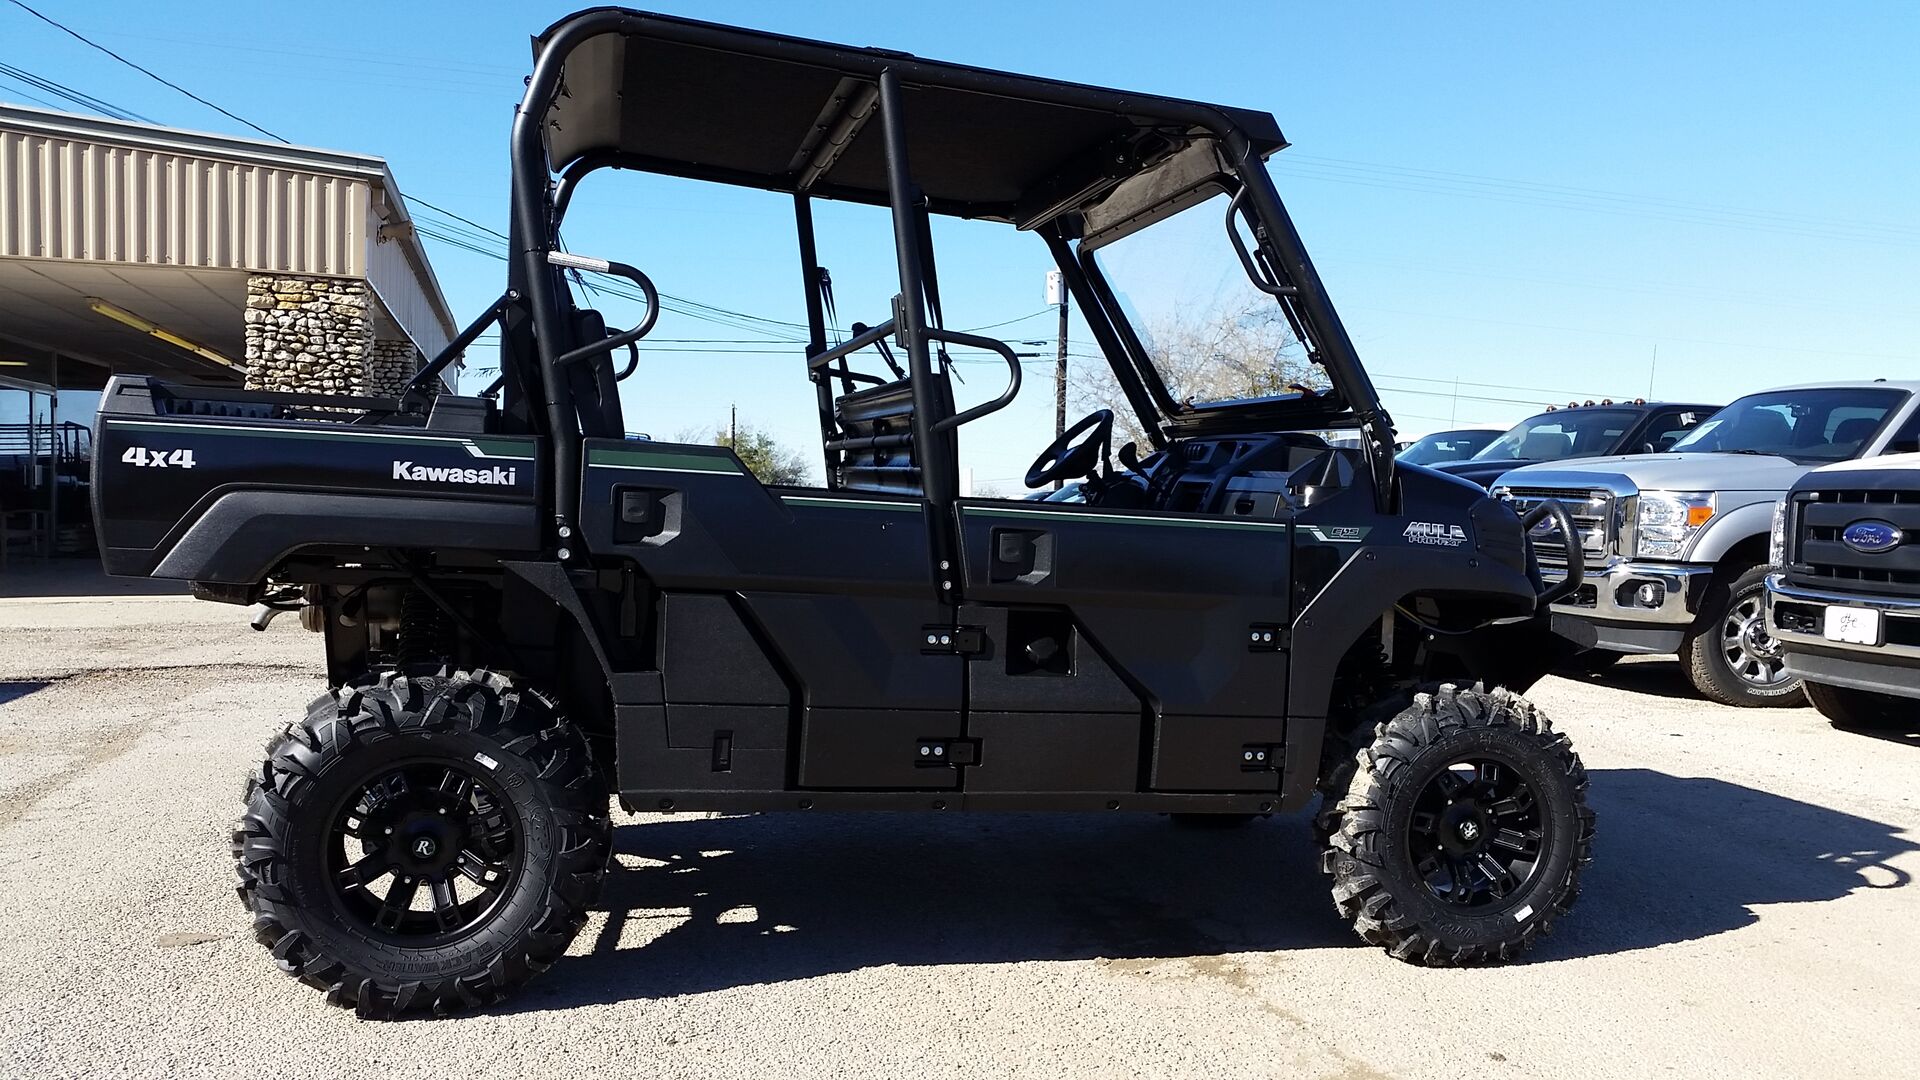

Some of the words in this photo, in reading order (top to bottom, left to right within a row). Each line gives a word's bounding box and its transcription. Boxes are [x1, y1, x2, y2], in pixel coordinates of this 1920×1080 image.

[122, 446, 196, 469] 4x4
[392, 460, 517, 487] Kawasaki
[1403, 521, 1468, 542] MULE
[1852, 526, 1884, 545] Ford
[415, 840, 432, 856] R
